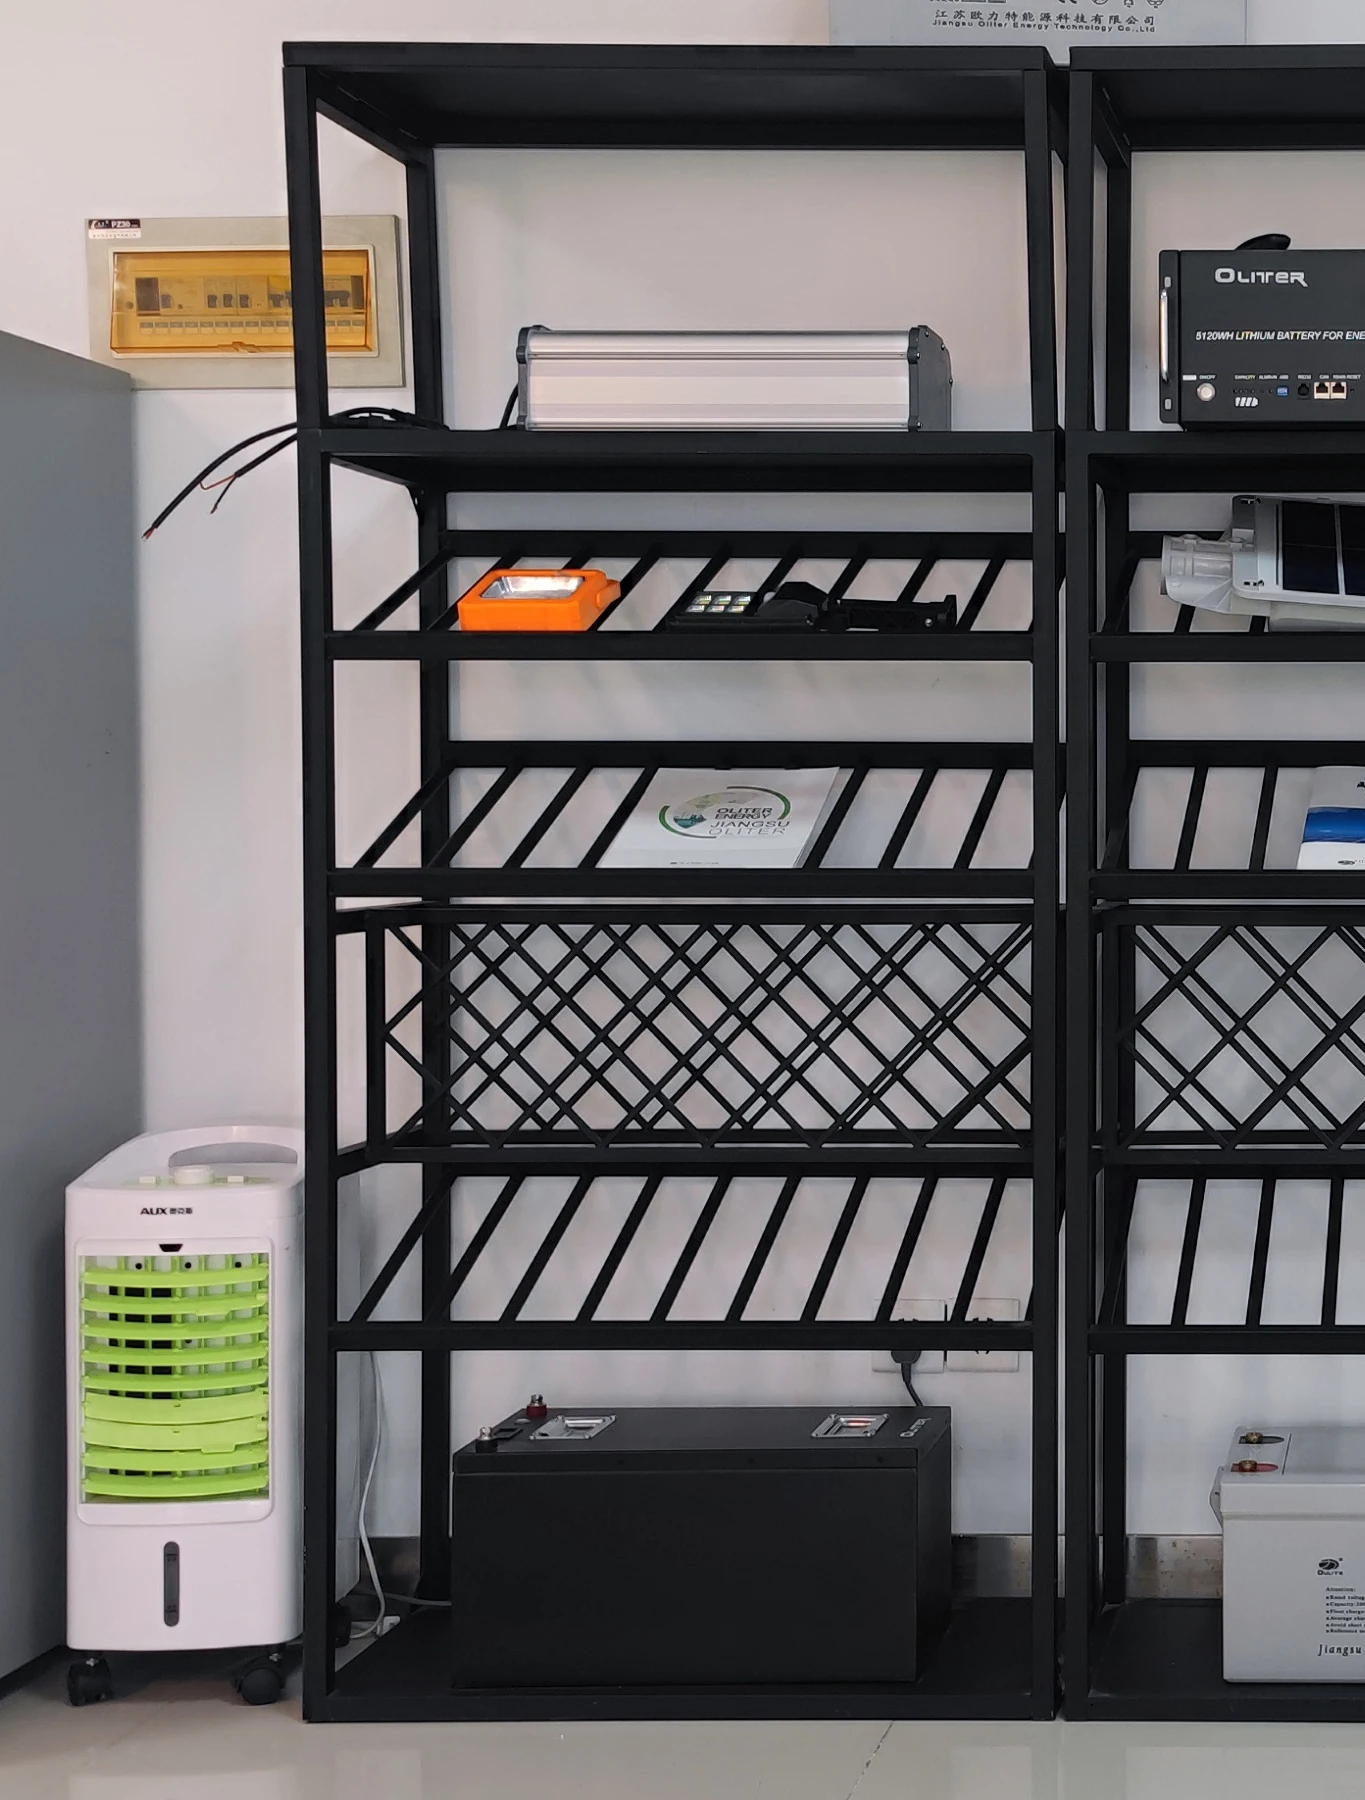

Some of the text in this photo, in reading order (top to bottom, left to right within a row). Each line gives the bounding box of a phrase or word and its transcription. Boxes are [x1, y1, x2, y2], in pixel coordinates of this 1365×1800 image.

[935, 9, 1154, 26] 江苏欧力特能源科技有限公司
[932, 19, 973, 28] Jiangsu
[1054, 22, 1112, 33] Technology
[1195, 330, 1234, 341] 5120WH
[1235, 330, 1276, 341] LITHIUM
[1276, 330, 1321, 341] BATTERY
[1322, 330, 1344, 341] FOR
[710, 820, 790, 828] JIANGSU
[708, 827, 786, 835] OLITER
[140, 1207, 168, 1215] AUX
[1317, 1643, 1362, 1657] Jiangsu
